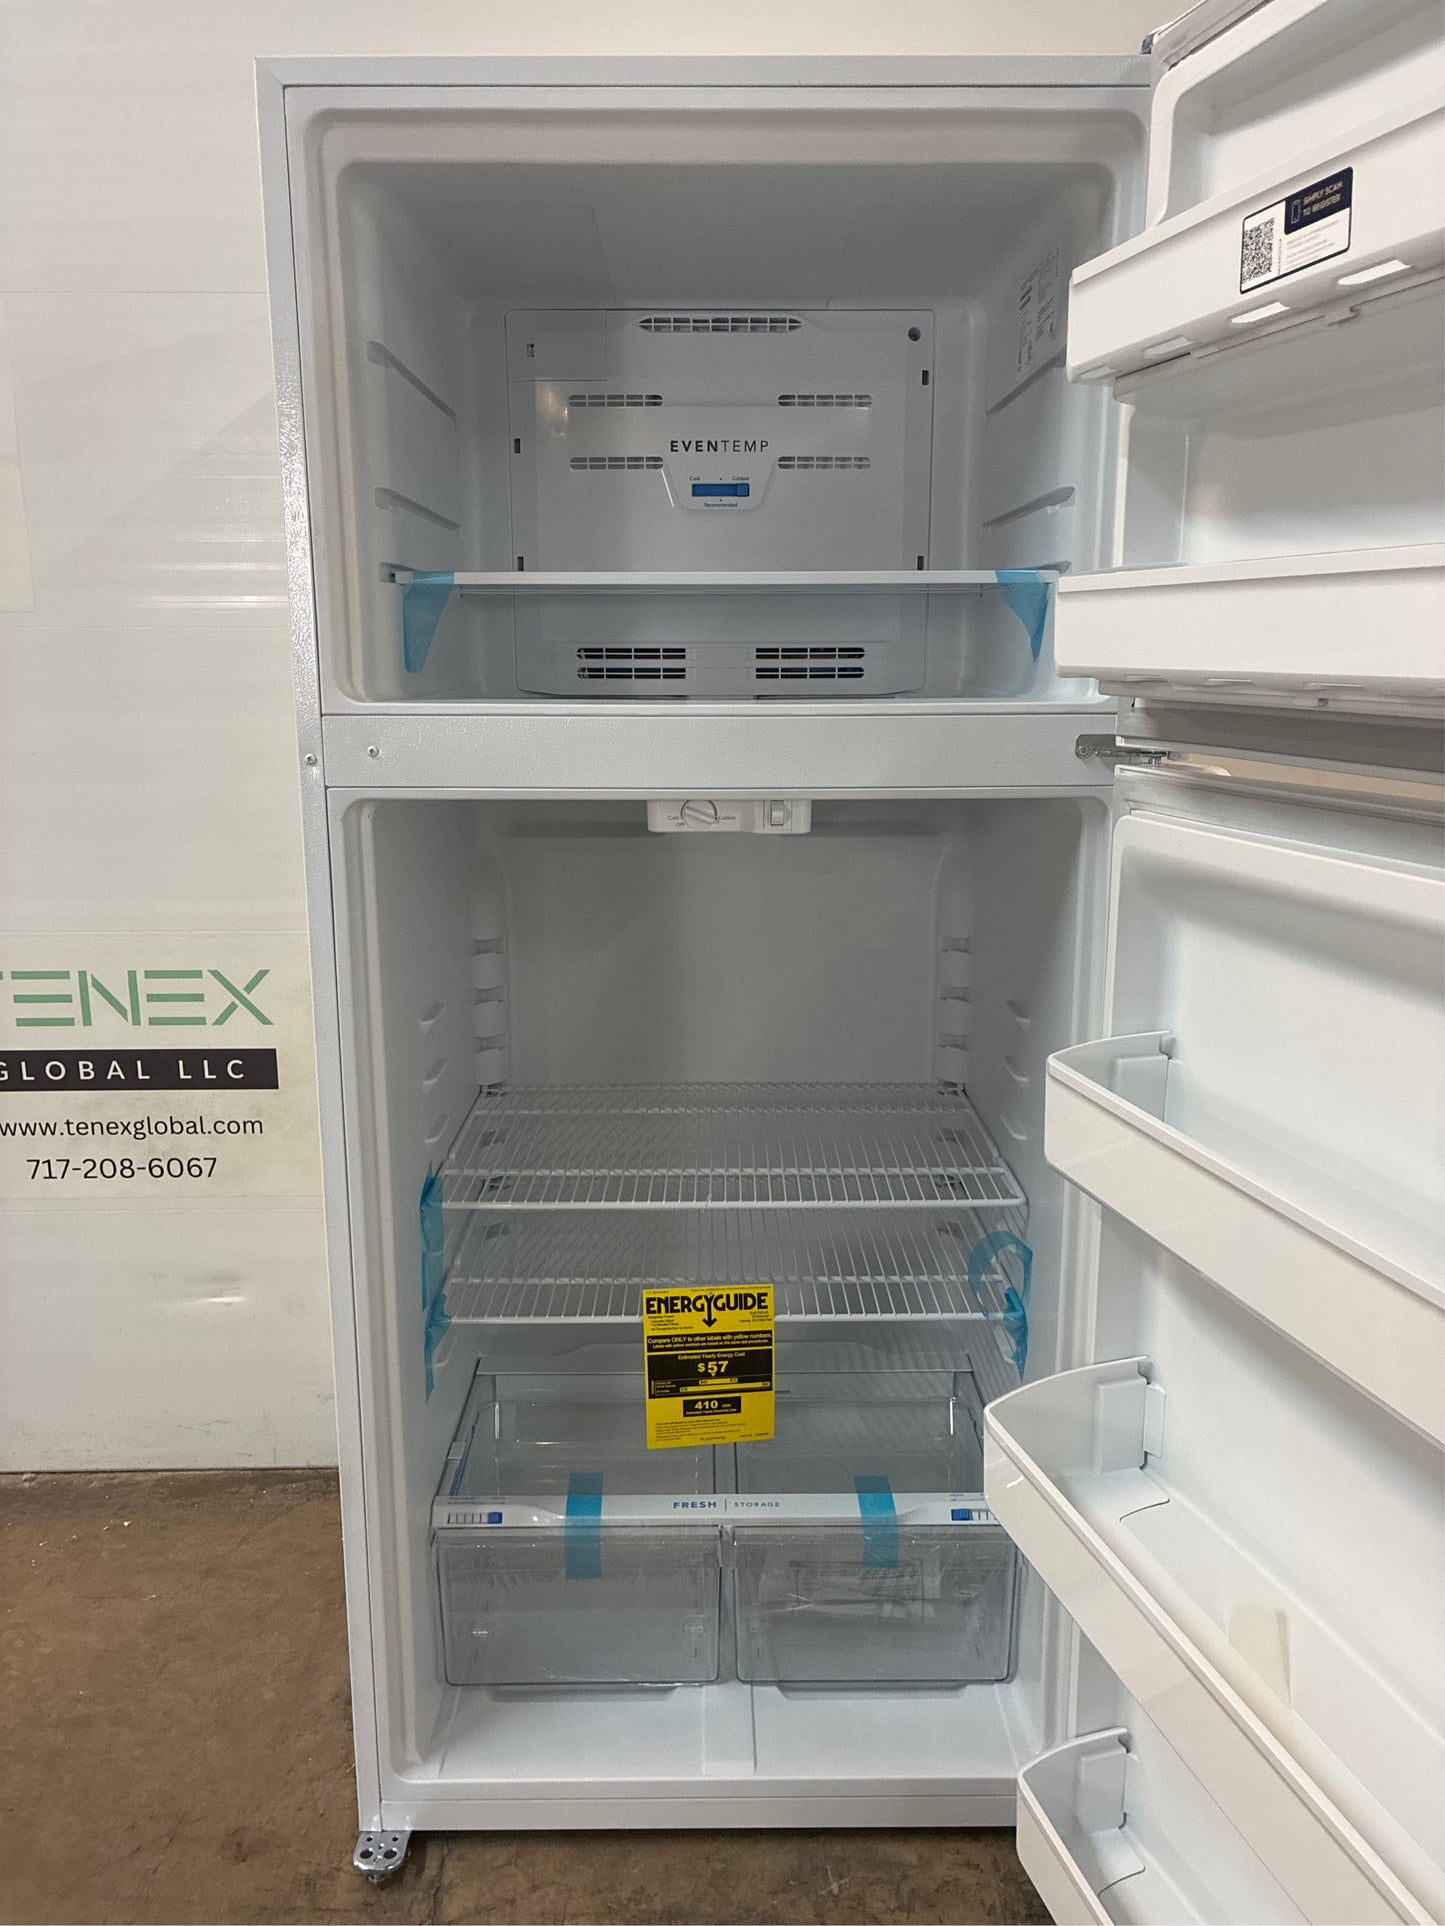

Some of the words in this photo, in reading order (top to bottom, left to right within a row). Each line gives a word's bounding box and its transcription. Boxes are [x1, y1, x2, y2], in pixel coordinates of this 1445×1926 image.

[670, 440, 769, 453] EVENTEMP
[0, 969, 274, 1027] ENEX
[178, 1060, 244, 1079] LLC
[0, 1116, 263, 1140] www.tenexglobal.com
[26, 1158, 217, 1180] 717-208-6067
[694, 1400, 719, 1410] 410
[673, 1501, 717, 1509] FRESH
